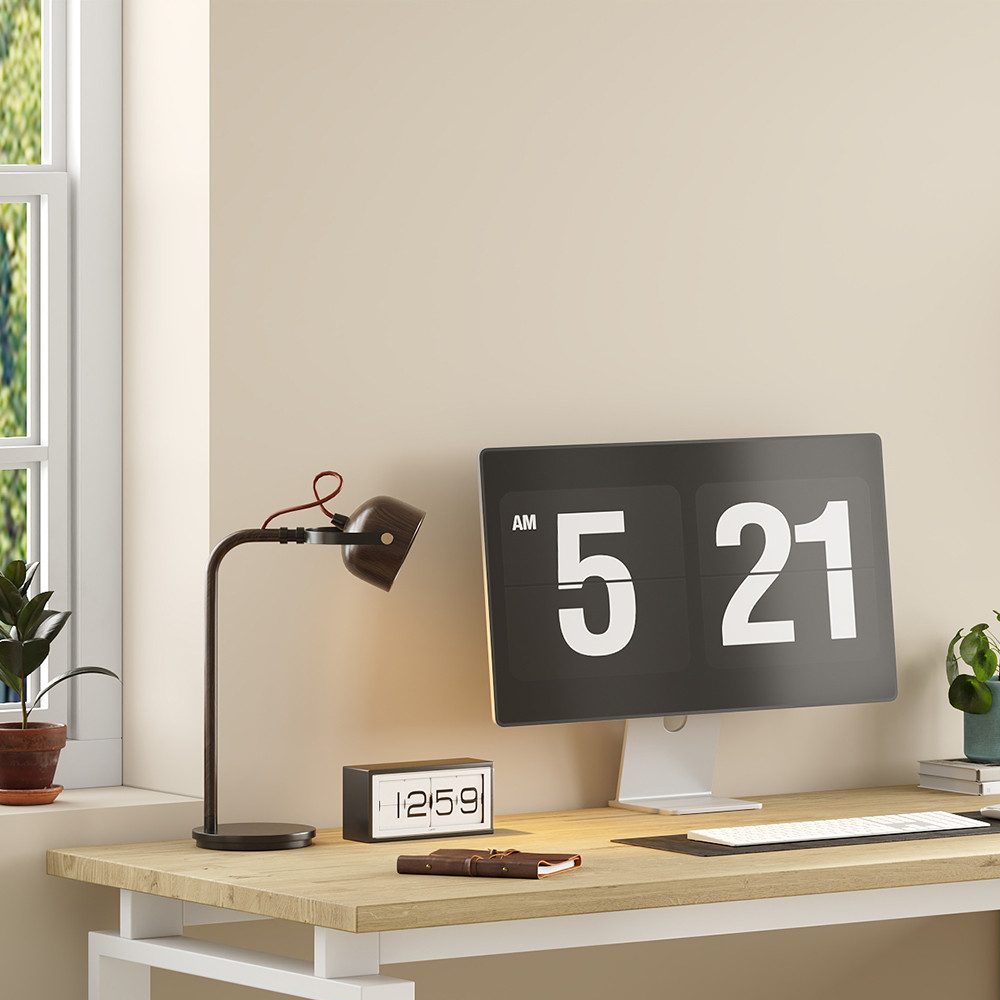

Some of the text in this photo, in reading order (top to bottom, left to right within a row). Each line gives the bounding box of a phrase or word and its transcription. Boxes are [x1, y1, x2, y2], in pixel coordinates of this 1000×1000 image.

[513, 513, 537, 531] AM
[557, 500, 857, 657] 5 21
